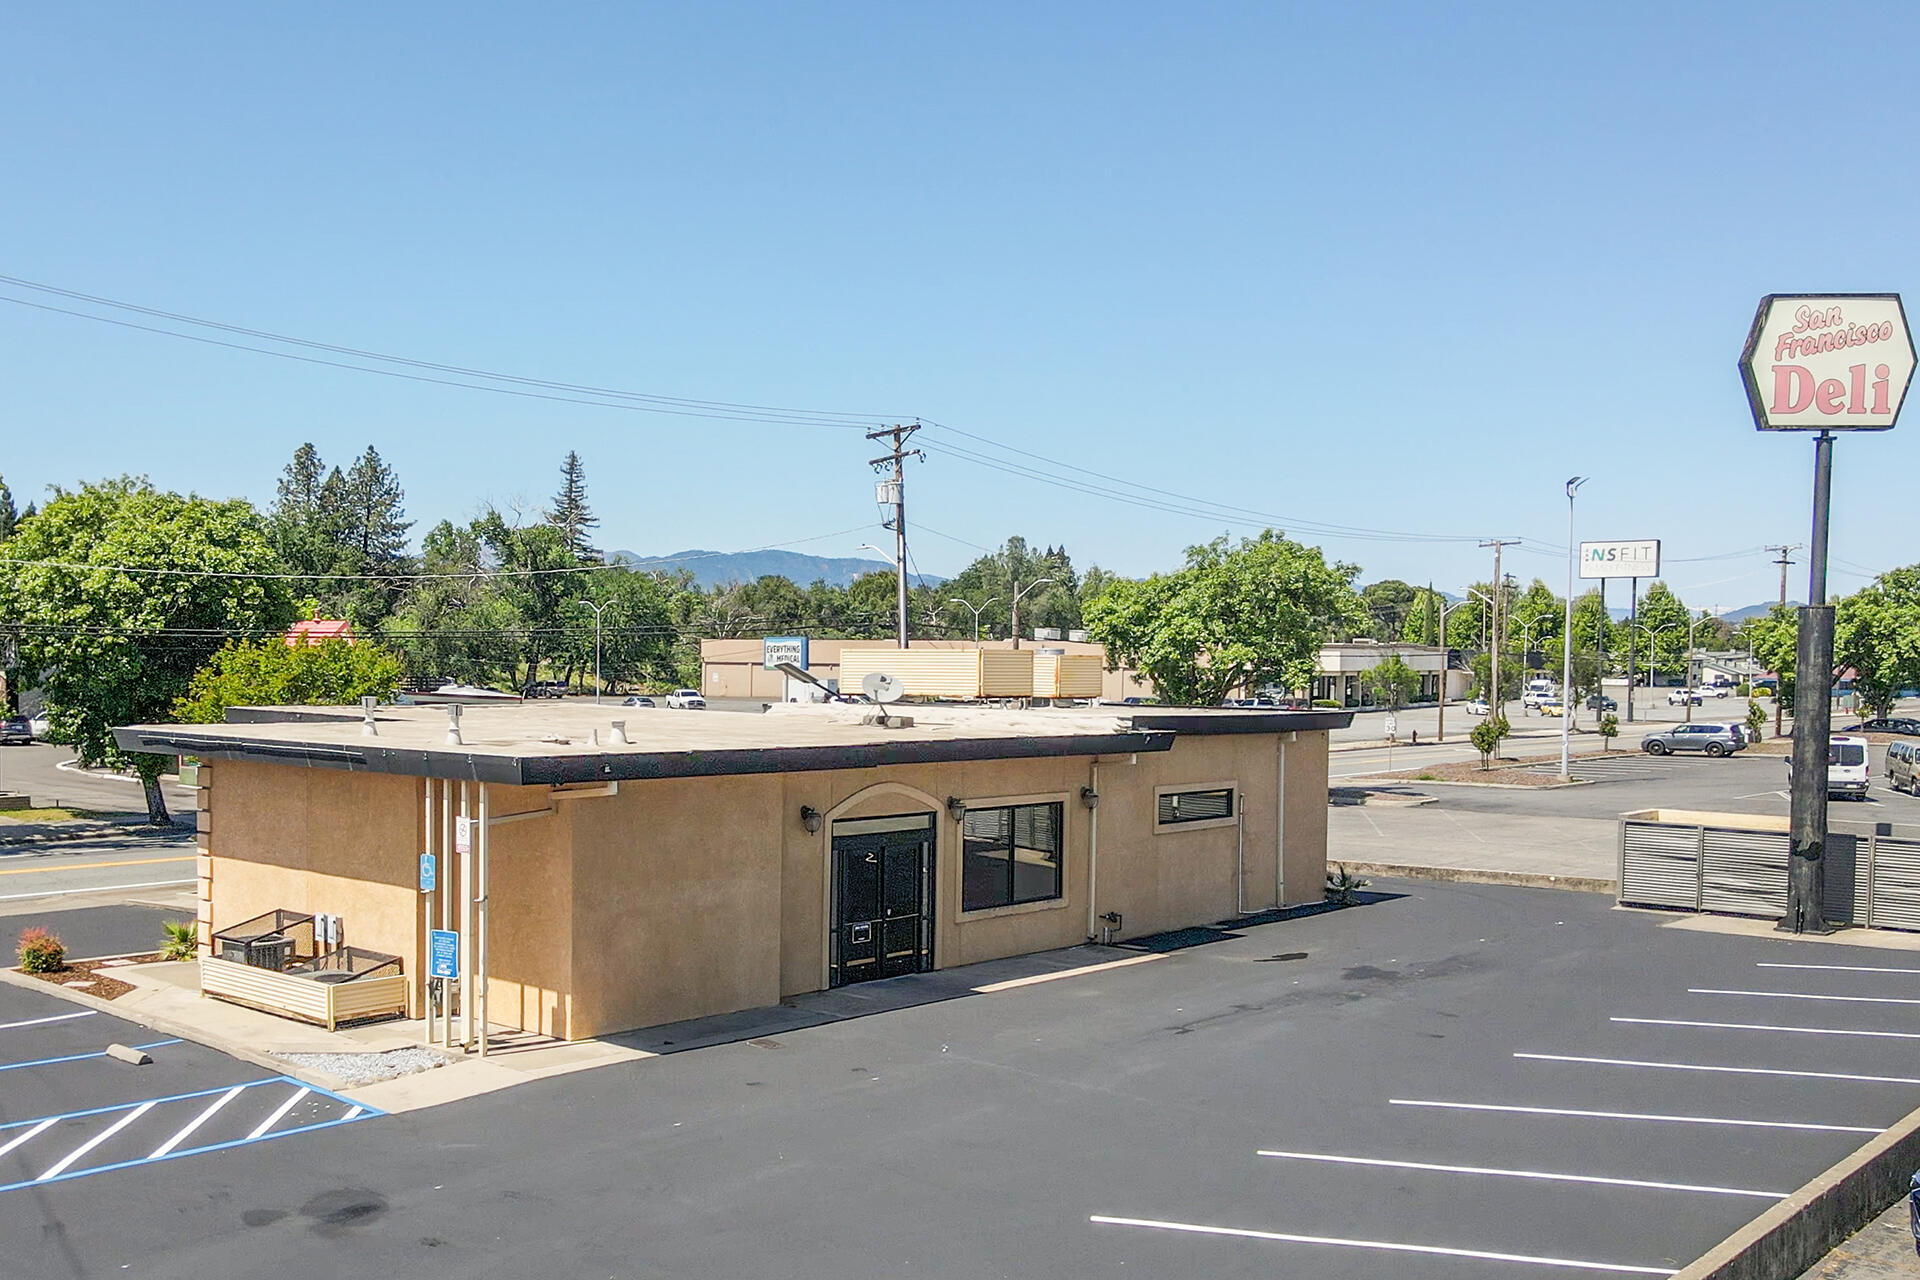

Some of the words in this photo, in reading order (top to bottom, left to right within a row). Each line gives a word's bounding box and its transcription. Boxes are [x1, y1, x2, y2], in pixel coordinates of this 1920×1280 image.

[1793, 305, 1843, 333] San
[1775, 321, 1893, 361] Francisco
[1770, 364, 1891, 415] Deli
[767, 645, 800, 653] EVERYTHING
[776, 654, 800, 663] MEDICAL
